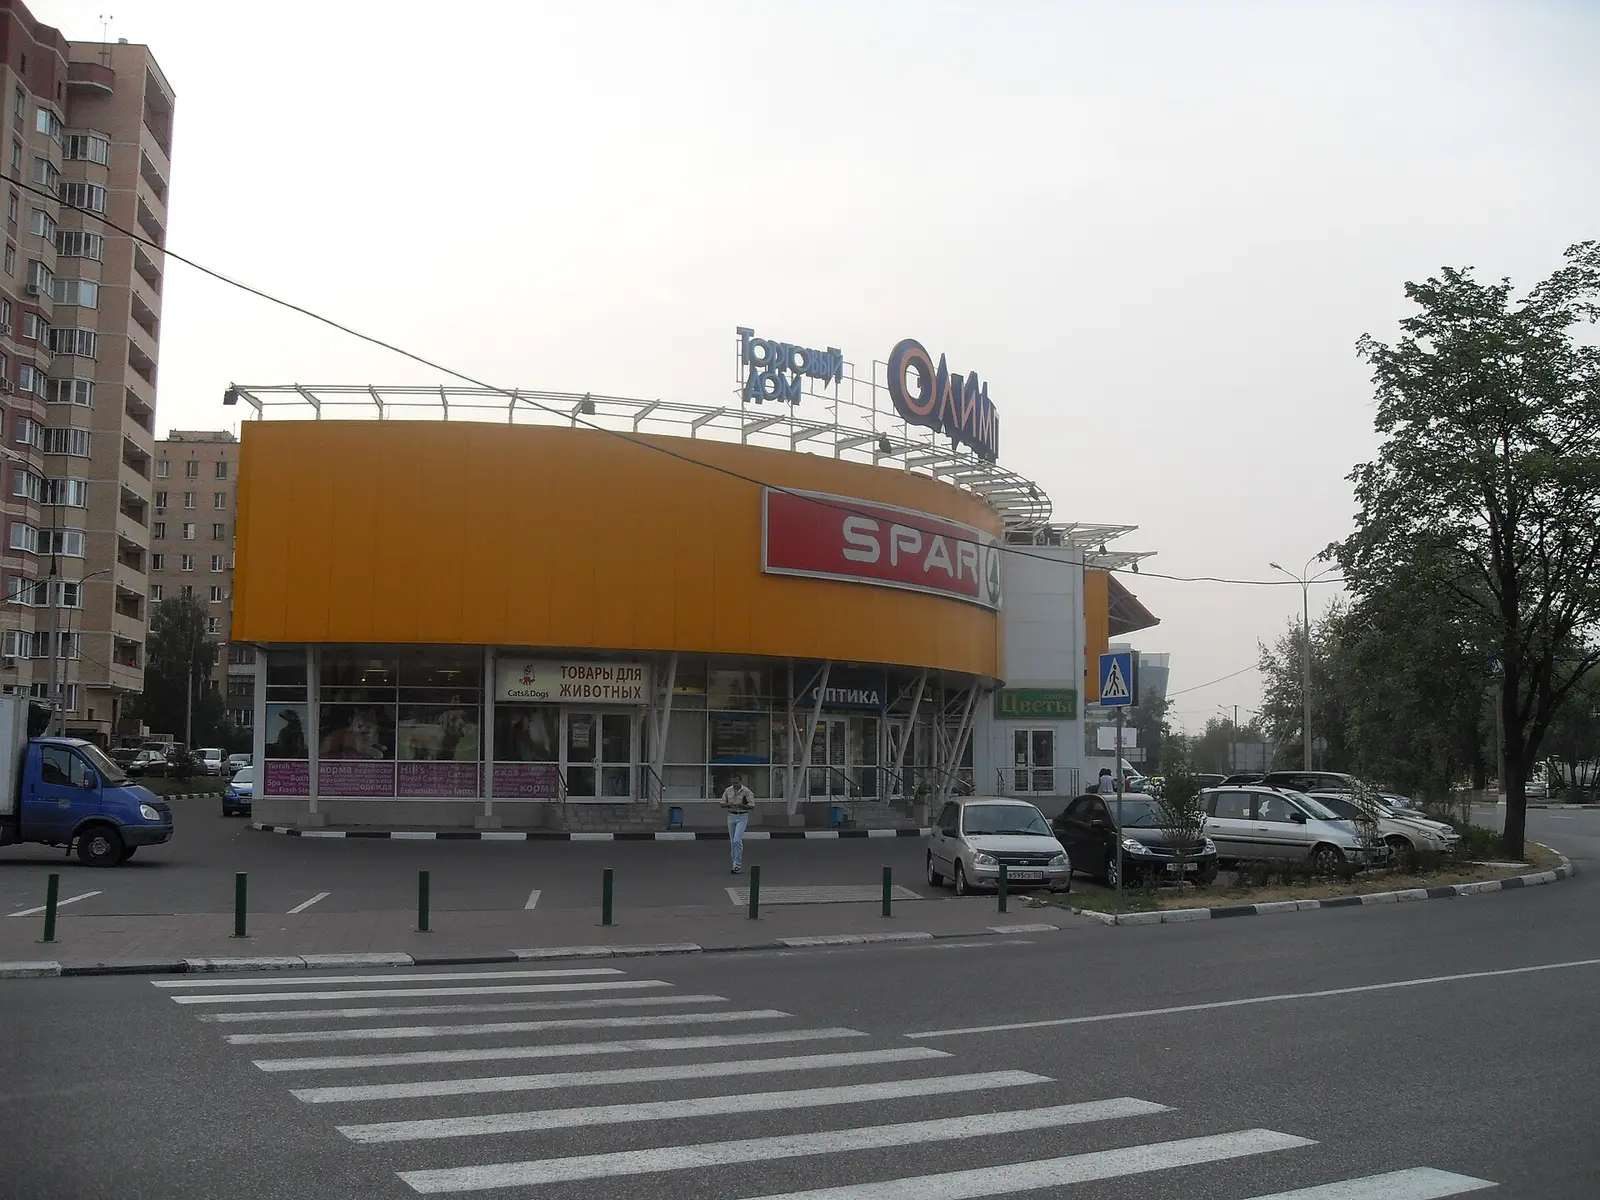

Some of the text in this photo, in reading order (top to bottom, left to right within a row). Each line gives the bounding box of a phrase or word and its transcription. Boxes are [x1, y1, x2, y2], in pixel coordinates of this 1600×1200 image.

[842, 516, 978, 584] SPAR
[560, 665, 642, 683] ТОВАРЫ ДЛЯ
[507, 689, 550, 699] Cats&Dogs
[559, 683, 642, 699] ЖИВОТНЫХ
[812, 687, 880, 705] ОПТИКА
[1001, 694, 1073, 715] Цветы
[400, 764, 426, 774] Hill's
